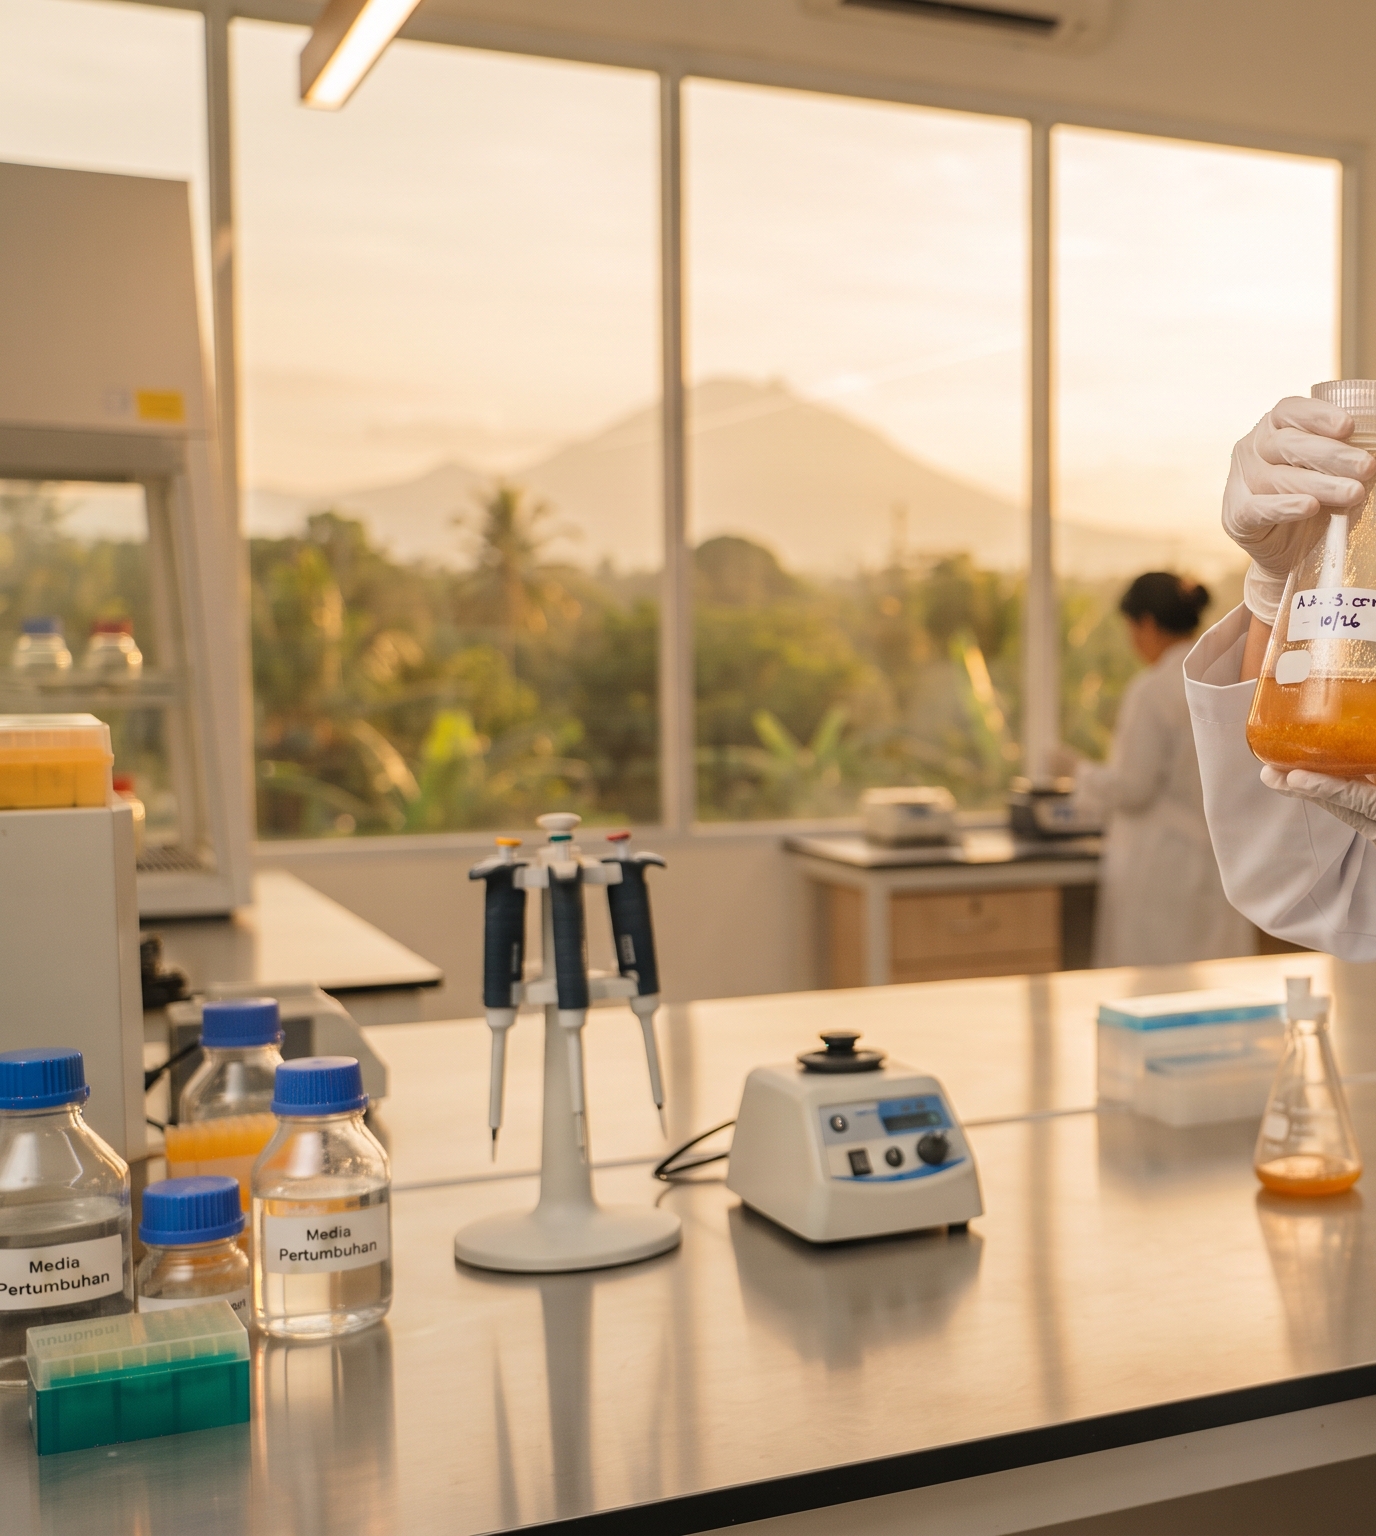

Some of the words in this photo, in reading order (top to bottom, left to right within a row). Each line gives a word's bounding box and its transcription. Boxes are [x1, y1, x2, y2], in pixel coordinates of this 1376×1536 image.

[1320, 611, 1361, 631] 10/26
[306, 1225, 351, 1241] Media
[279, 1241, 377, 1261] Pertumbuhan
[29, 1256, 80, 1274] Media
